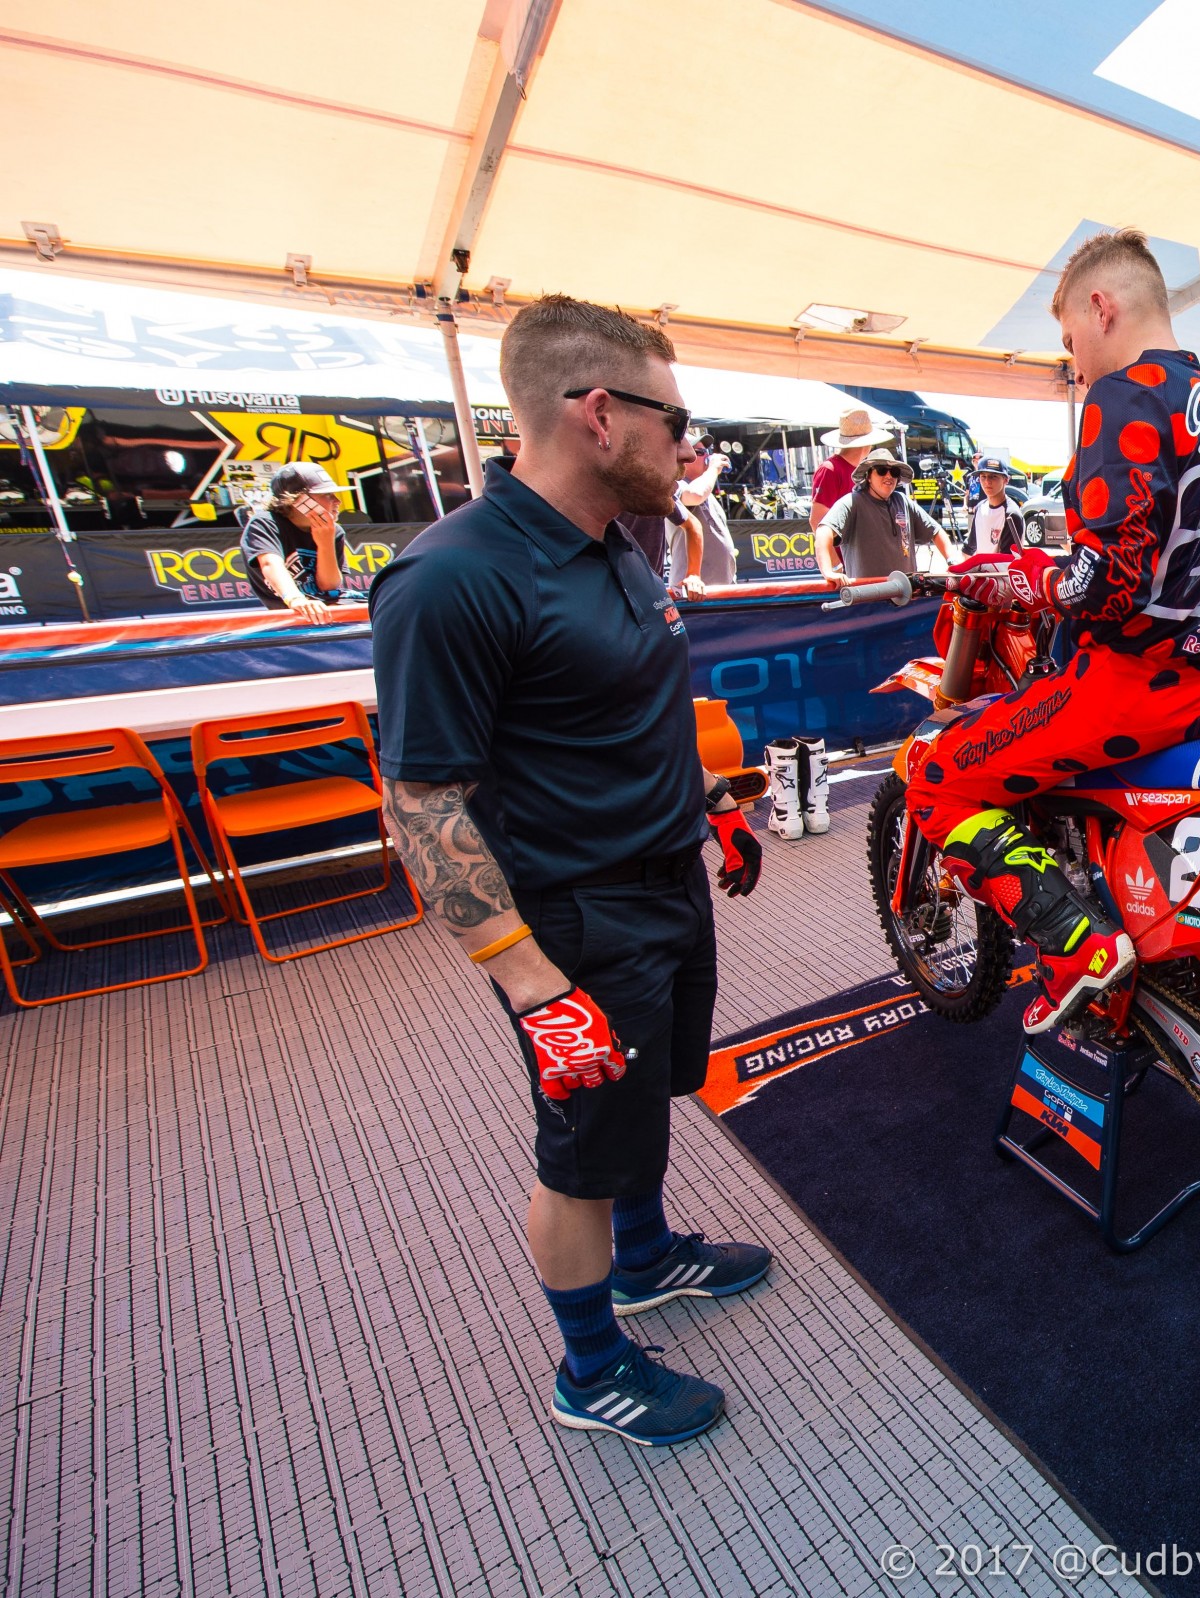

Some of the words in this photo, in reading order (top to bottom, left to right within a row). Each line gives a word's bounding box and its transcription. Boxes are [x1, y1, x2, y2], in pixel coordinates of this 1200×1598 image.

[953, 742, 987, 770] Troy
[985, 729, 1014, 755] Lee
[1010, 687, 1073, 738] Designs
[1142, 793, 1191, 805] seaspan
[1126, 901, 1155, 917] adidas
[863, 1002, 933, 1034] TORY
[1173, 1023, 1190, 1047] DID
[1044, 1089, 1074, 1115] GoPro
[1059, 1085, 1089, 1112] Designs
[1040, 1110, 1070, 1137] KTM
